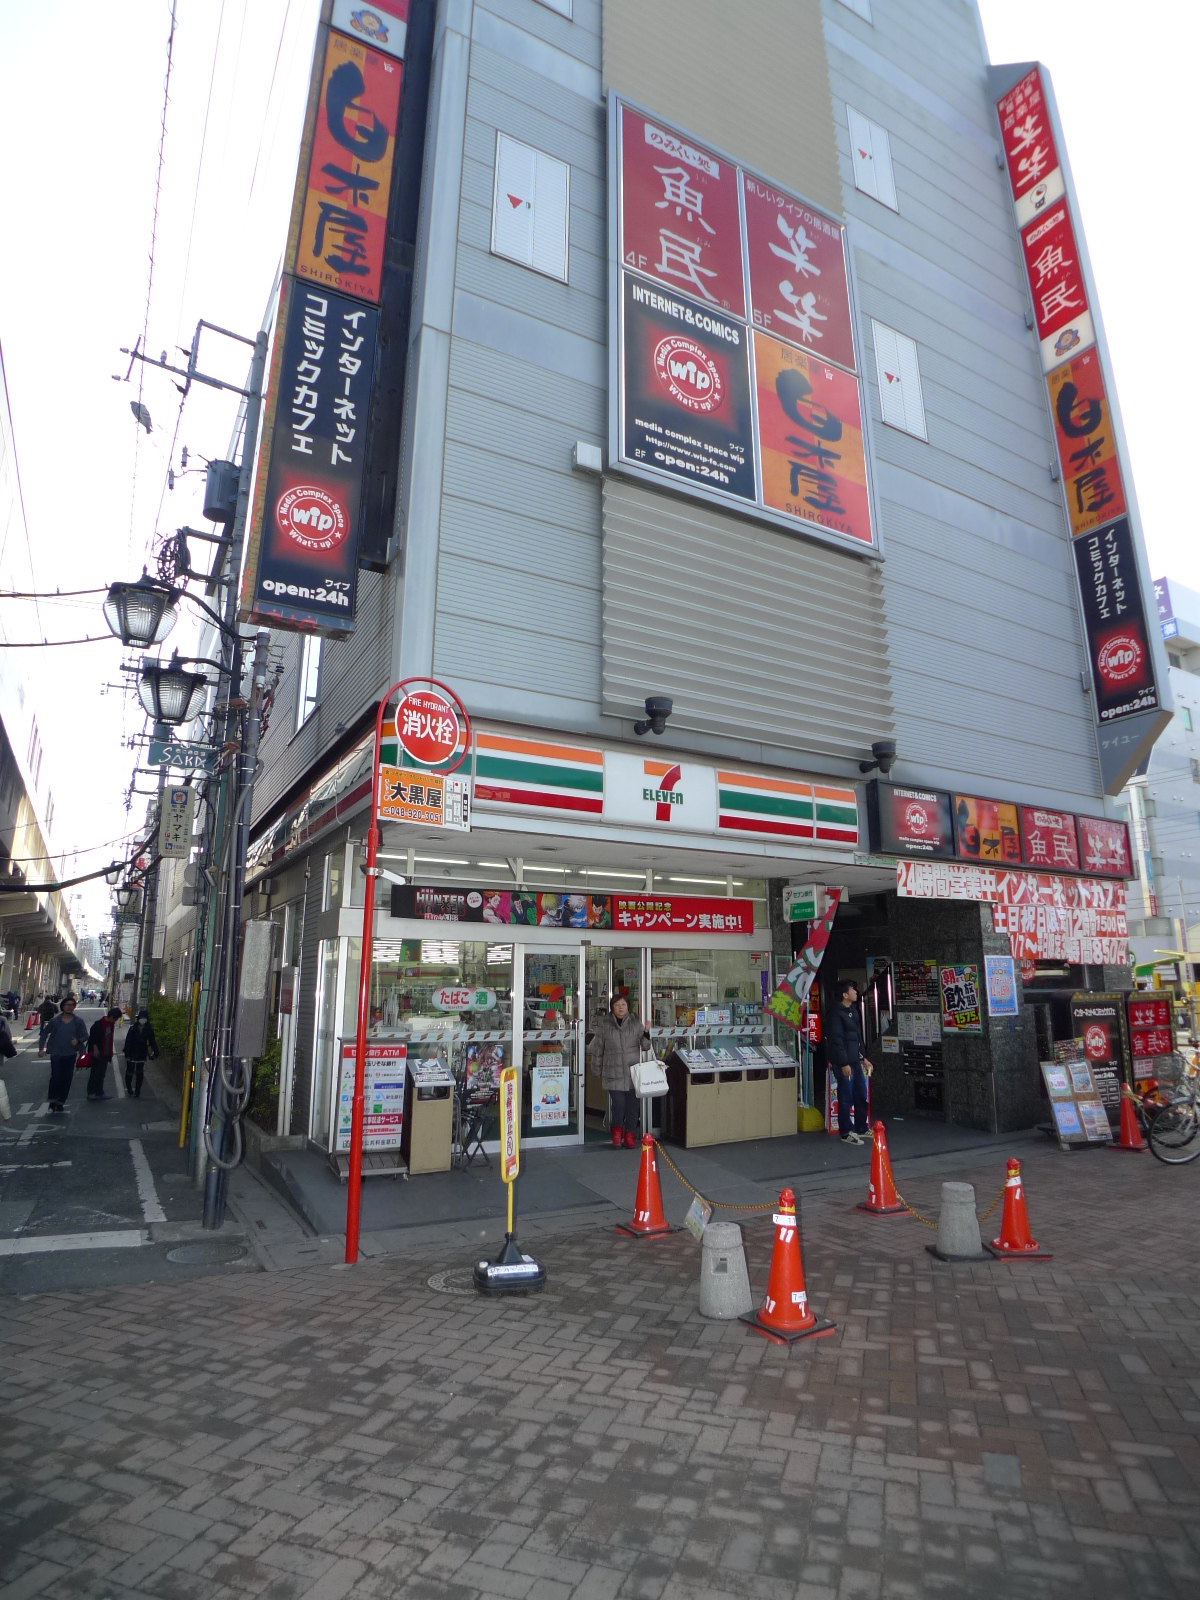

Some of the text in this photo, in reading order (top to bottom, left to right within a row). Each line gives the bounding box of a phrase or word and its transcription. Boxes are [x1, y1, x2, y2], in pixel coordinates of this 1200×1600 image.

[320, 60, 389, 277] 白木屋
[746, 180, 840, 241] 新しいタイプの居酒屋
[653, 164, 720, 304] 魚民
[625, 250, 648, 269] 4F
[300, 265, 374, 297] SHIROKIYA
[1031, 244, 1082, 324] 魚民
[632, 284, 740, 345] INTERNET&COMICS
[753, 308, 772, 327] 5F
[291, 293, 328, 455] コミックカフェ
[330, 311, 366, 466] インターネット
[670, 359, 710, 390] wip
[635, 418, 745, 465] media complex space wip
[775, 367, 846, 515] 白木屋
[1056, 381, 1115, 514] 白木屋
[634, 448, 730, 485] 2F open:24h
[279, 488, 344, 528] Media Complex Space
[292, 506, 333, 531] wip
[785, 502, 854, 534] SHIROKIYA
[1087, 536, 1111, 619] コミックカフェ
[1104, 528, 1127, 615] インターネット
[262, 579, 349, 607] open:24h
[1107, 649, 1134, 668] wip
[408, 696, 450, 714] FIRE HYDRANT
[1101, 695, 1156, 719] open:24h
[402, 708, 454, 746] 消火栓
[395, 781, 447, 809] 大黒屋
[643, 759, 682, 822] 7
[893, 788, 937, 802] INTERNET&COMICS
[172, 813, 183, 842] ヤマキ
[395, 806, 448, 823] 048-920-3051
[910, 813, 924, 825] wip
[1027, 829, 1075, 867] 魚民
[897, 860, 996, 900] 24時間営業中
[416, 891, 465, 905] HUNTER
[618, 900, 672, 912] 映画公開記念
[440, 990, 488, 1005] たばこ 酒
[351, 1049, 381, 1057] セン銀行
[1091, 1035, 1103, 1047] wip
